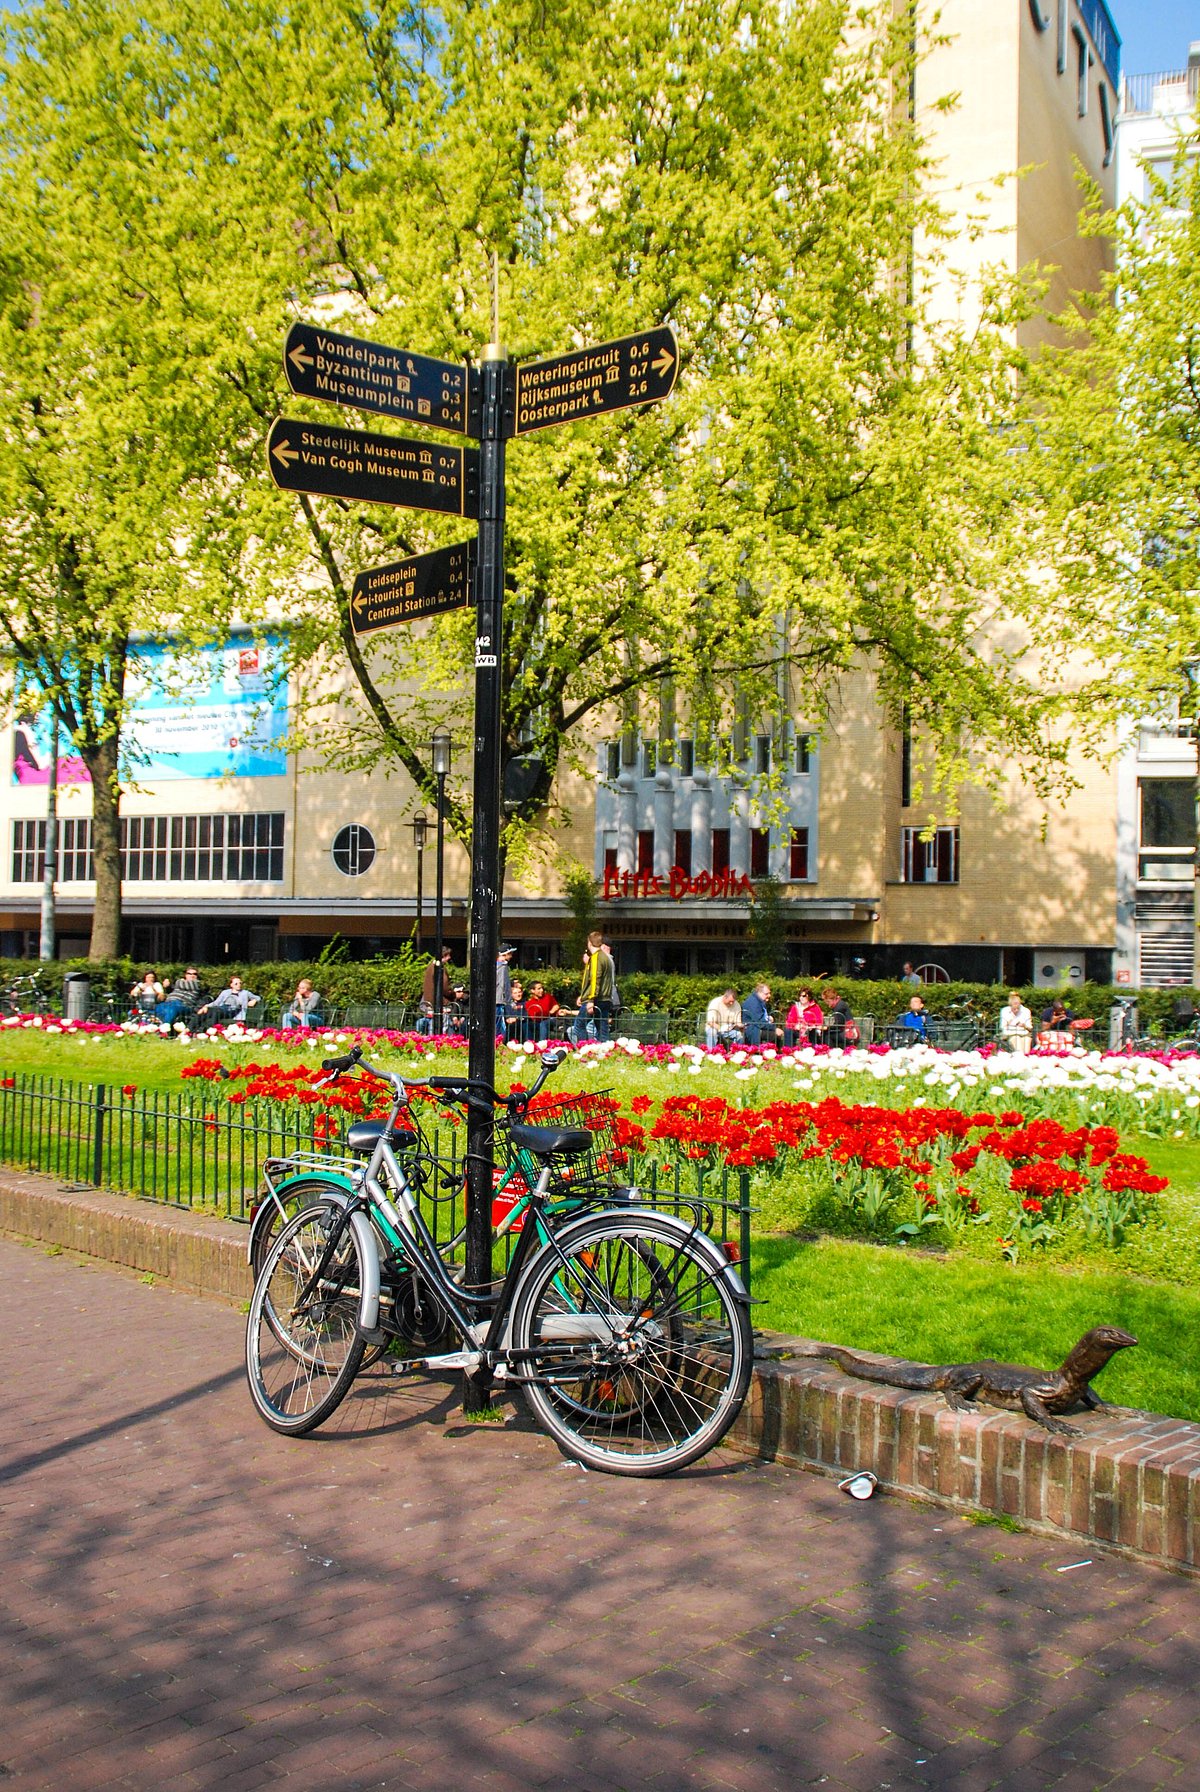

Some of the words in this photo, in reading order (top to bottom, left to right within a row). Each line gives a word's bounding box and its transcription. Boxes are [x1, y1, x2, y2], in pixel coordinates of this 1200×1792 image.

[316, 336, 401, 371] Vondelpark
[442, 372, 461, 387] 0,2
[316, 356, 393, 387] Byzantium
[442, 390, 461, 405] 0,3
[521, 349, 621, 389] Weteringcircuit
[630, 342, 650, 359] 0,6
[316, 374, 414, 411] Museumplein
[442, 408, 461, 422] 0,4
[520, 374, 603, 407] Rijksmuseum
[629, 362, 649, 377] 0,7
[520, 394, 589, 424] Oosterpark
[629, 380, 648, 397] 2,6
[301, 432, 360, 453] Stedelijk
[364, 442, 416, 462] Museum
[439, 456, 456, 468] 0,7
[301, 451, 326, 466] Van
[330, 456, 363, 473] Gogh
[367, 462, 419, 481] Museum
[439, 475, 457, 486] 0,8
[368, 566, 417, 589] Leidseplein
[450, 555, 462, 566] 0,1
[368, 588, 404, 606] i-tourist
[450, 571, 463, 583] 0,4
[367, 604, 403, 621] Centraal
[405, 596, 436, 612] Station
[449, 589, 462, 601] 2,4
[603, 864, 665, 902] LITTLE
[668, 865, 758, 900] BUDDHA
